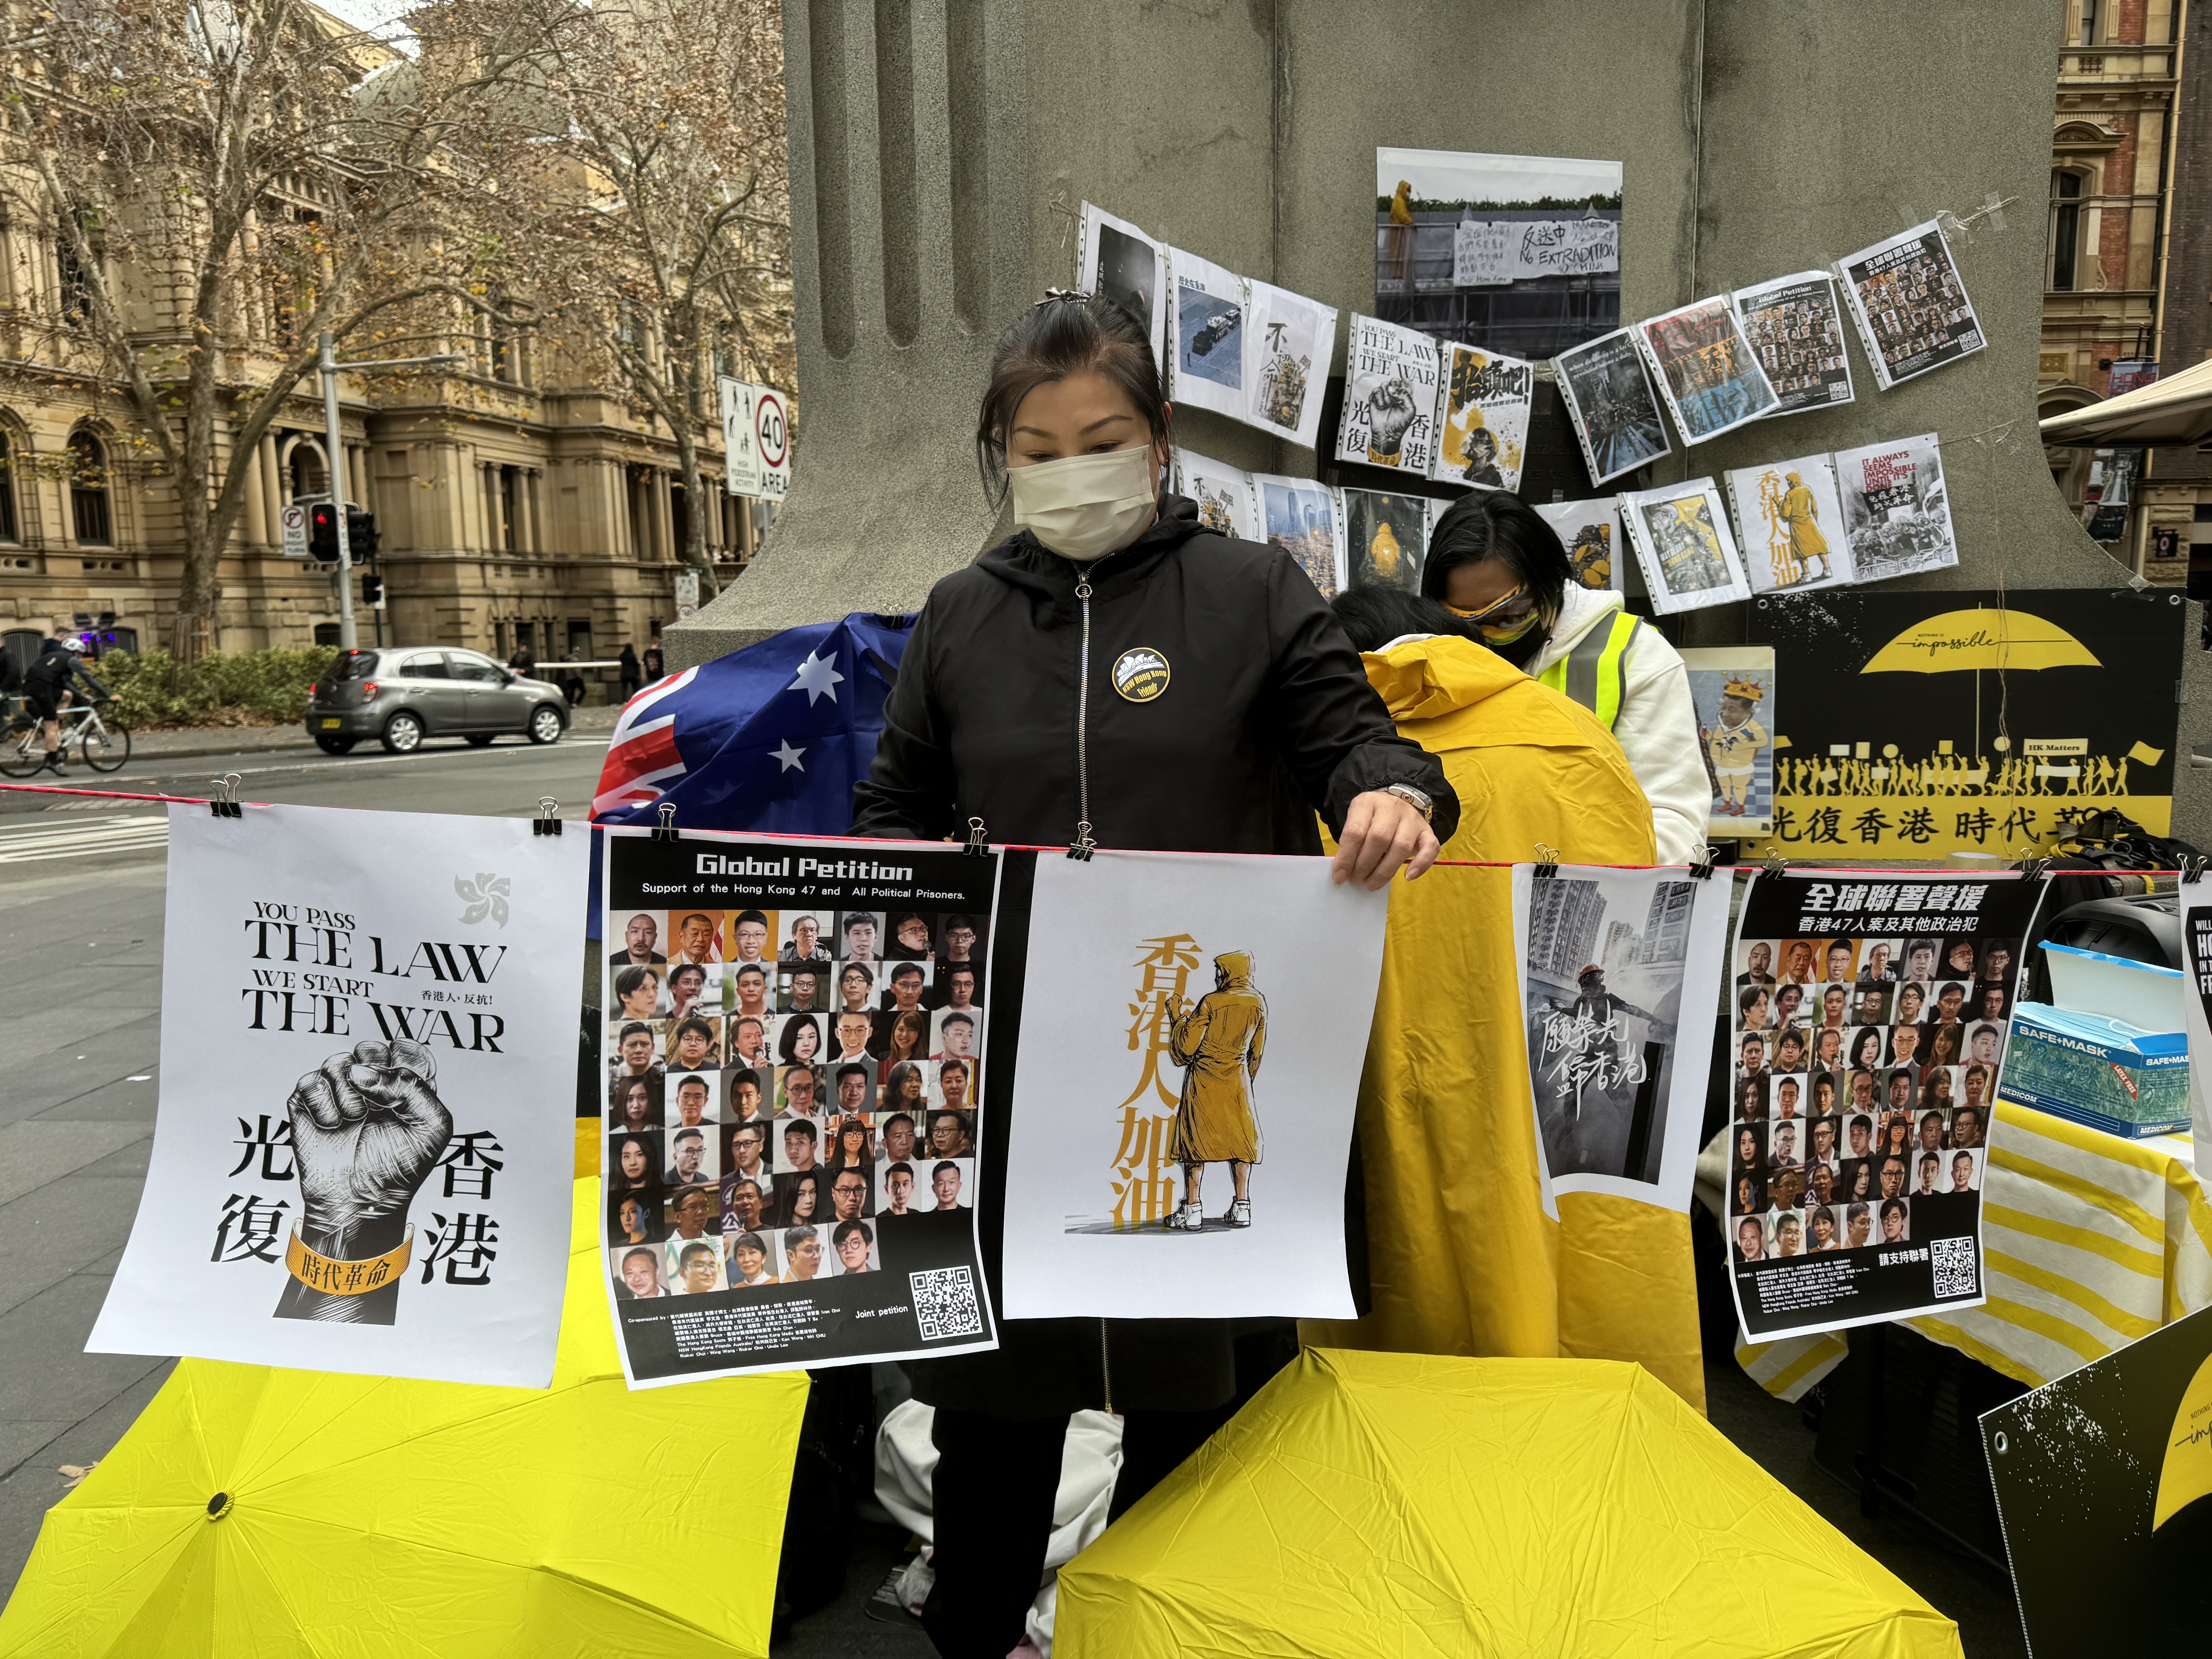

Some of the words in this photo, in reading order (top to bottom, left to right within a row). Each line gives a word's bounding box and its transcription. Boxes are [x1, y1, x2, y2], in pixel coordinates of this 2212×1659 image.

[1523, 225, 1565, 251] 反送中
[1520, 250, 1533, 264] No
[1539, 242, 1617, 264] EXTRADITION
[1758, 292, 1782, 302] Global
[1782, 285, 1812, 296] Petition
[1380, 328, 1396, 337] PASS
[1362, 330, 1394, 351] THE
[1399, 340, 1436, 361] LAW
[1377, 351, 1400, 362] START
[1360, 354, 1391, 376] THE
[1396, 363, 1435, 386] WAR
[2113, 372, 2155, 383] HONG
[762, 414, 783, 449] 40
[1347, 400, 1370, 454] 光復
[1404, 414, 1431, 469] 香港
[1863, 461, 1892, 472] SEEMS
[1872, 451, 1909, 464] ALWAYS
[1864, 463, 1917, 479] IMPOSSIBLE
[1865, 475, 1892, 486] UNTIL
[1894, 472, 1908, 481] IT'S
[1866, 481, 1892, 493] DONE
[1754, 470, 1799, 589] 香港人加油
[1913, 630, 1997, 657] impossible
[1122, 678, 1135, 694] NSW
[1134, 672, 1152, 684] Hong
[1137, 682, 1158, 698] Friends
[1773, 805, 1939, 845] 光復香港
[697, 854, 790, 877] Global
[798, 857, 913, 881] Petition
[642, 883, 687, 894] Support
[693, 883, 704, 893] of
[710, 883, 728, 893] the
[734, 884, 762, 895] Hong
[768, 884, 795, 896] Kong
[801, 886, 816, 895] 47
[821, 887, 840, 896] and
[852, 887, 866, 896] All
[871, 888, 911, 898] Political
[916, 888, 965, 900] Prisoners.
[1801, 883, 1989, 911] 全球聯署聲援
[253, 901, 298, 921] YOU
[306, 907, 356, 930] PASS
[1798, 916, 1979, 932] 香港47人案及其他政治犯
[245, 920, 352, 969] THE
[368, 936, 507, 983] LAW
[2199, 960, 2207, 973] IN
[252, 969, 295, 988] WE
[303, 974, 374, 998] START
[242, 989, 350, 1036] THE
[366, 1001, 504, 1054] WAR
[1109, 933, 1204, 1232] 香港人加油
[2114, 1065, 2128, 1083] LATEX
[2124, 1079, 2136, 1094] FREE
[2000, 1086, 2038, 1103] MEDICOM
[2140, 1125, 2173, 1134] MEDICOM
[210, 1114, 294, 1263] 光復
[420, 1130, 505, 1286] 香港
[1879, 1247, 1929, 1267] 請支持聯署
[301, 1252, 391, 1291] 時代革命
[855, 1308, 874, 1320] Joint
[878, 1304, 908, 1318] petition
[2190, 1403, 2211, 1420] NOTHING
